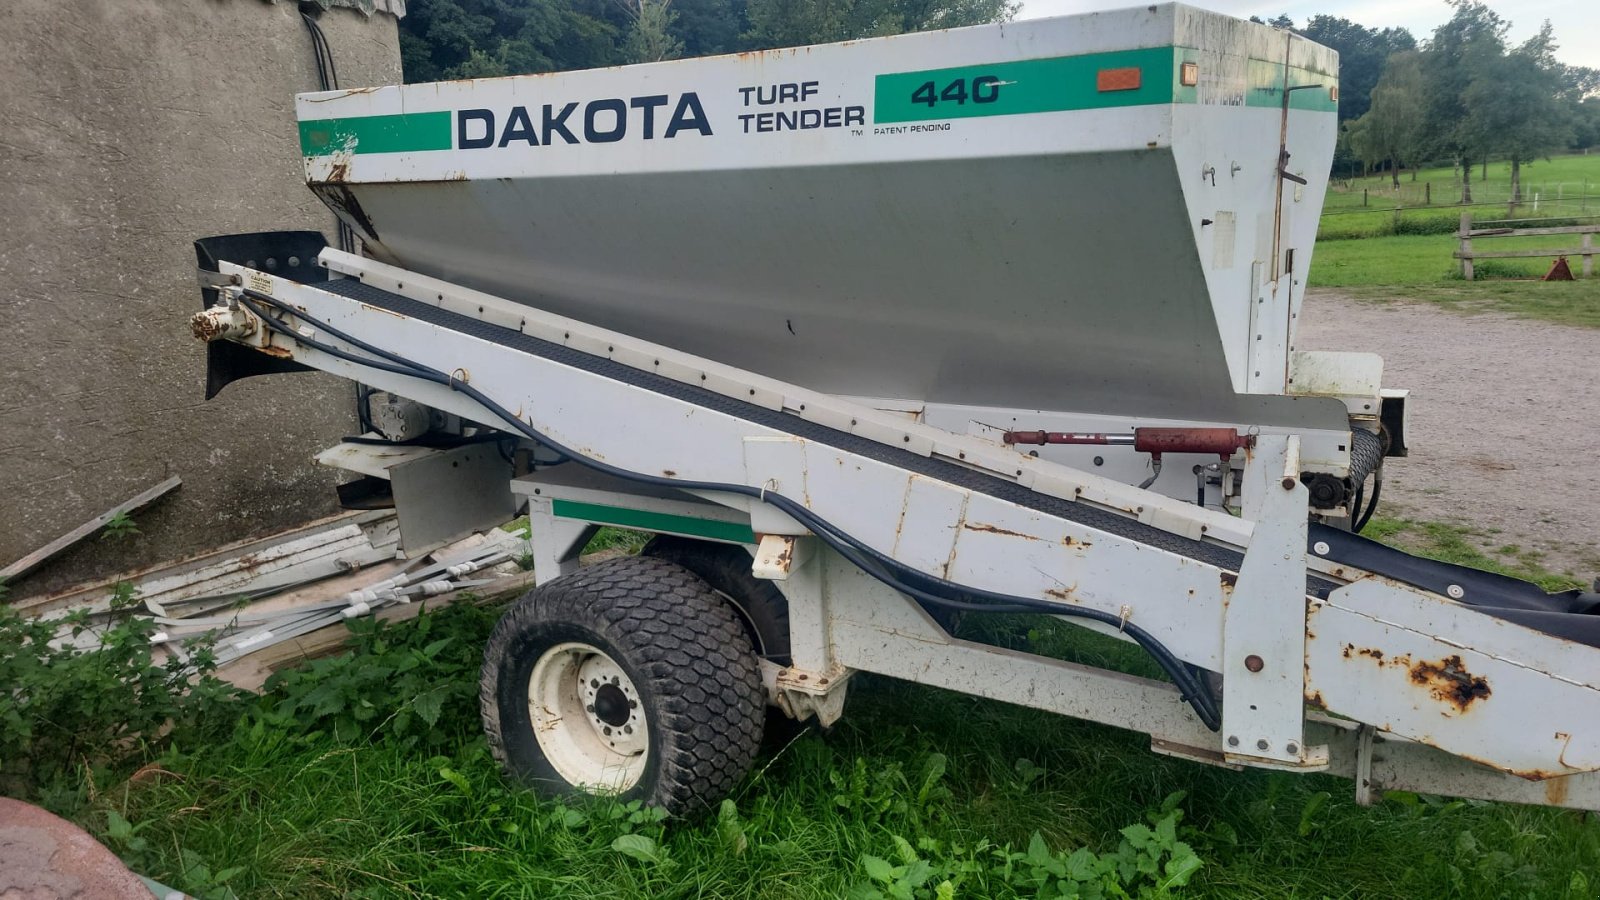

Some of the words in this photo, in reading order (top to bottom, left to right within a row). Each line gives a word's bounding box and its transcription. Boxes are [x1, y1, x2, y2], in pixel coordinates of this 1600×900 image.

[739, 81, 819, 106] TURF
[911, 75, 1000, 107] 440
[458, 92, 714, 149] DAKOTA
[738, 105, 865, 133] TENDER
[874, 126, 908, 136] PATENT
[910, 123, 951, 133] PENDING
